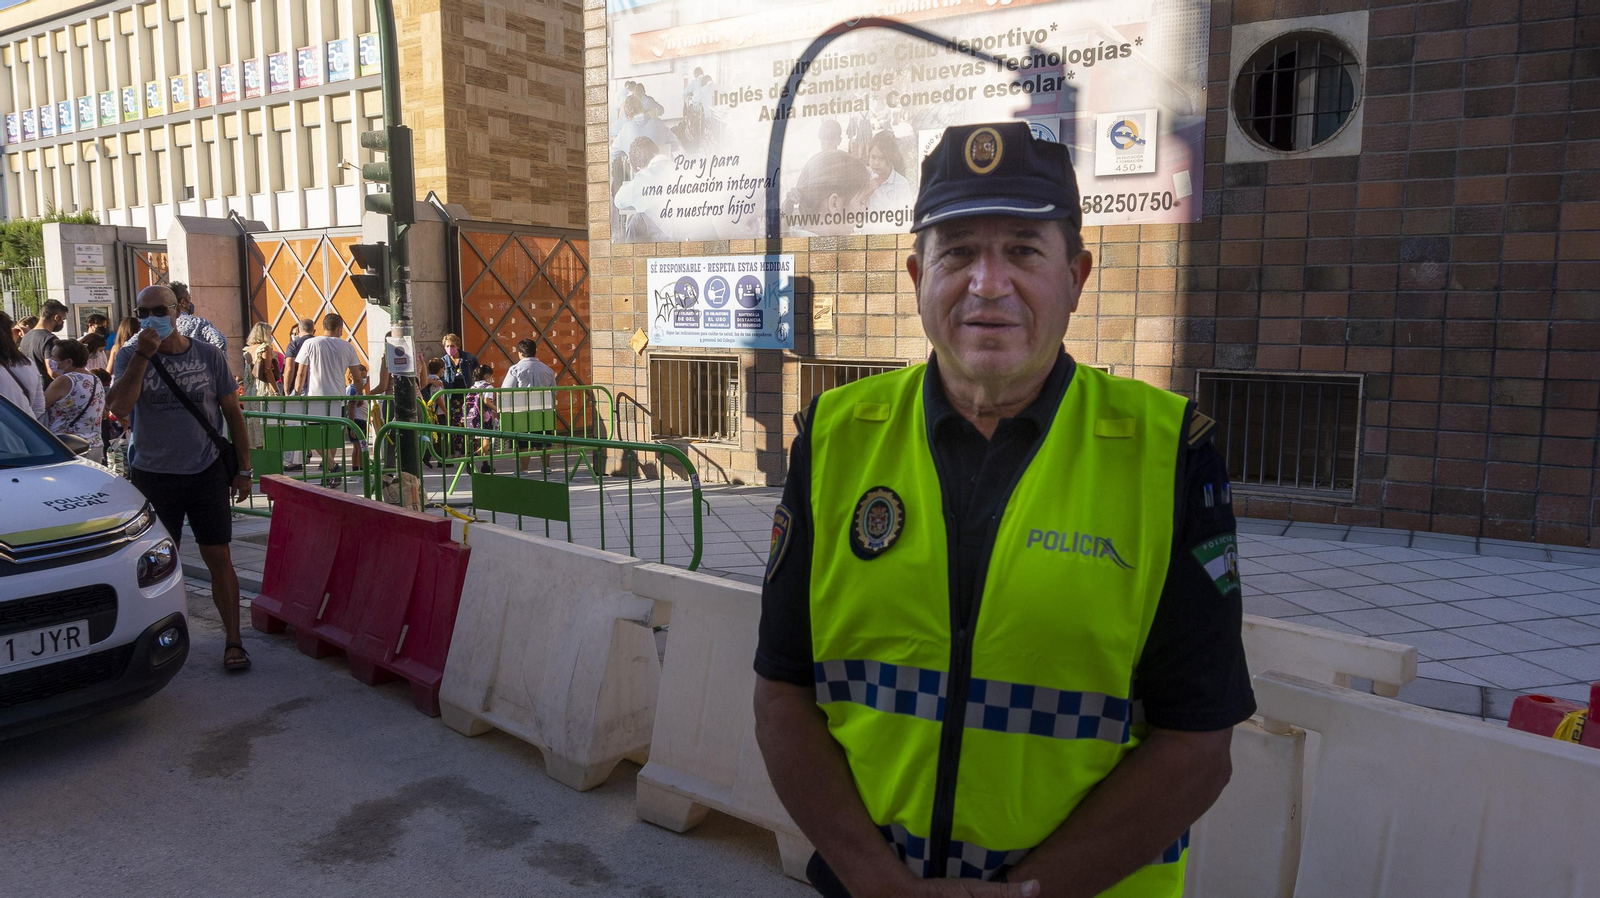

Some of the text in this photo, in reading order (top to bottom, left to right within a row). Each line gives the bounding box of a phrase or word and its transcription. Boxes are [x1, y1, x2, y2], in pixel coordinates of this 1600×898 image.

[894, 42, 938, 62] Club
[911, 60, 986, 83] Nuevas
[714, 86, 763, 109] Inglés
[769, 83, 790, 99] de
[759, 104, 796, 122] Aula
[887, 84, 977, 109] Comedor
[674, 154, 740, 179] Por y para
[1115, 163, 1144, 172] 450+
[642, 167, 780, 199] una educación integral
[660, 195, 756, 224] de nuestros hijos
[1082, 191, 1173, 214] 58250750
[650, 262, 658, 273] SÉ
[659, 262, 701, 274] RESPONSABLE
[707, 262, 736, 273] RESPETA
[738, 262, 758, 272] ESTAS
[760, 261, 790, 272] MEDIDAS
[170, 372, 210, 392] ooper
[53, 499, 108, 512] LOCAL
[1027, 529, 1112, 558] POLICIA
[31, 626, 81, 656] JYR
